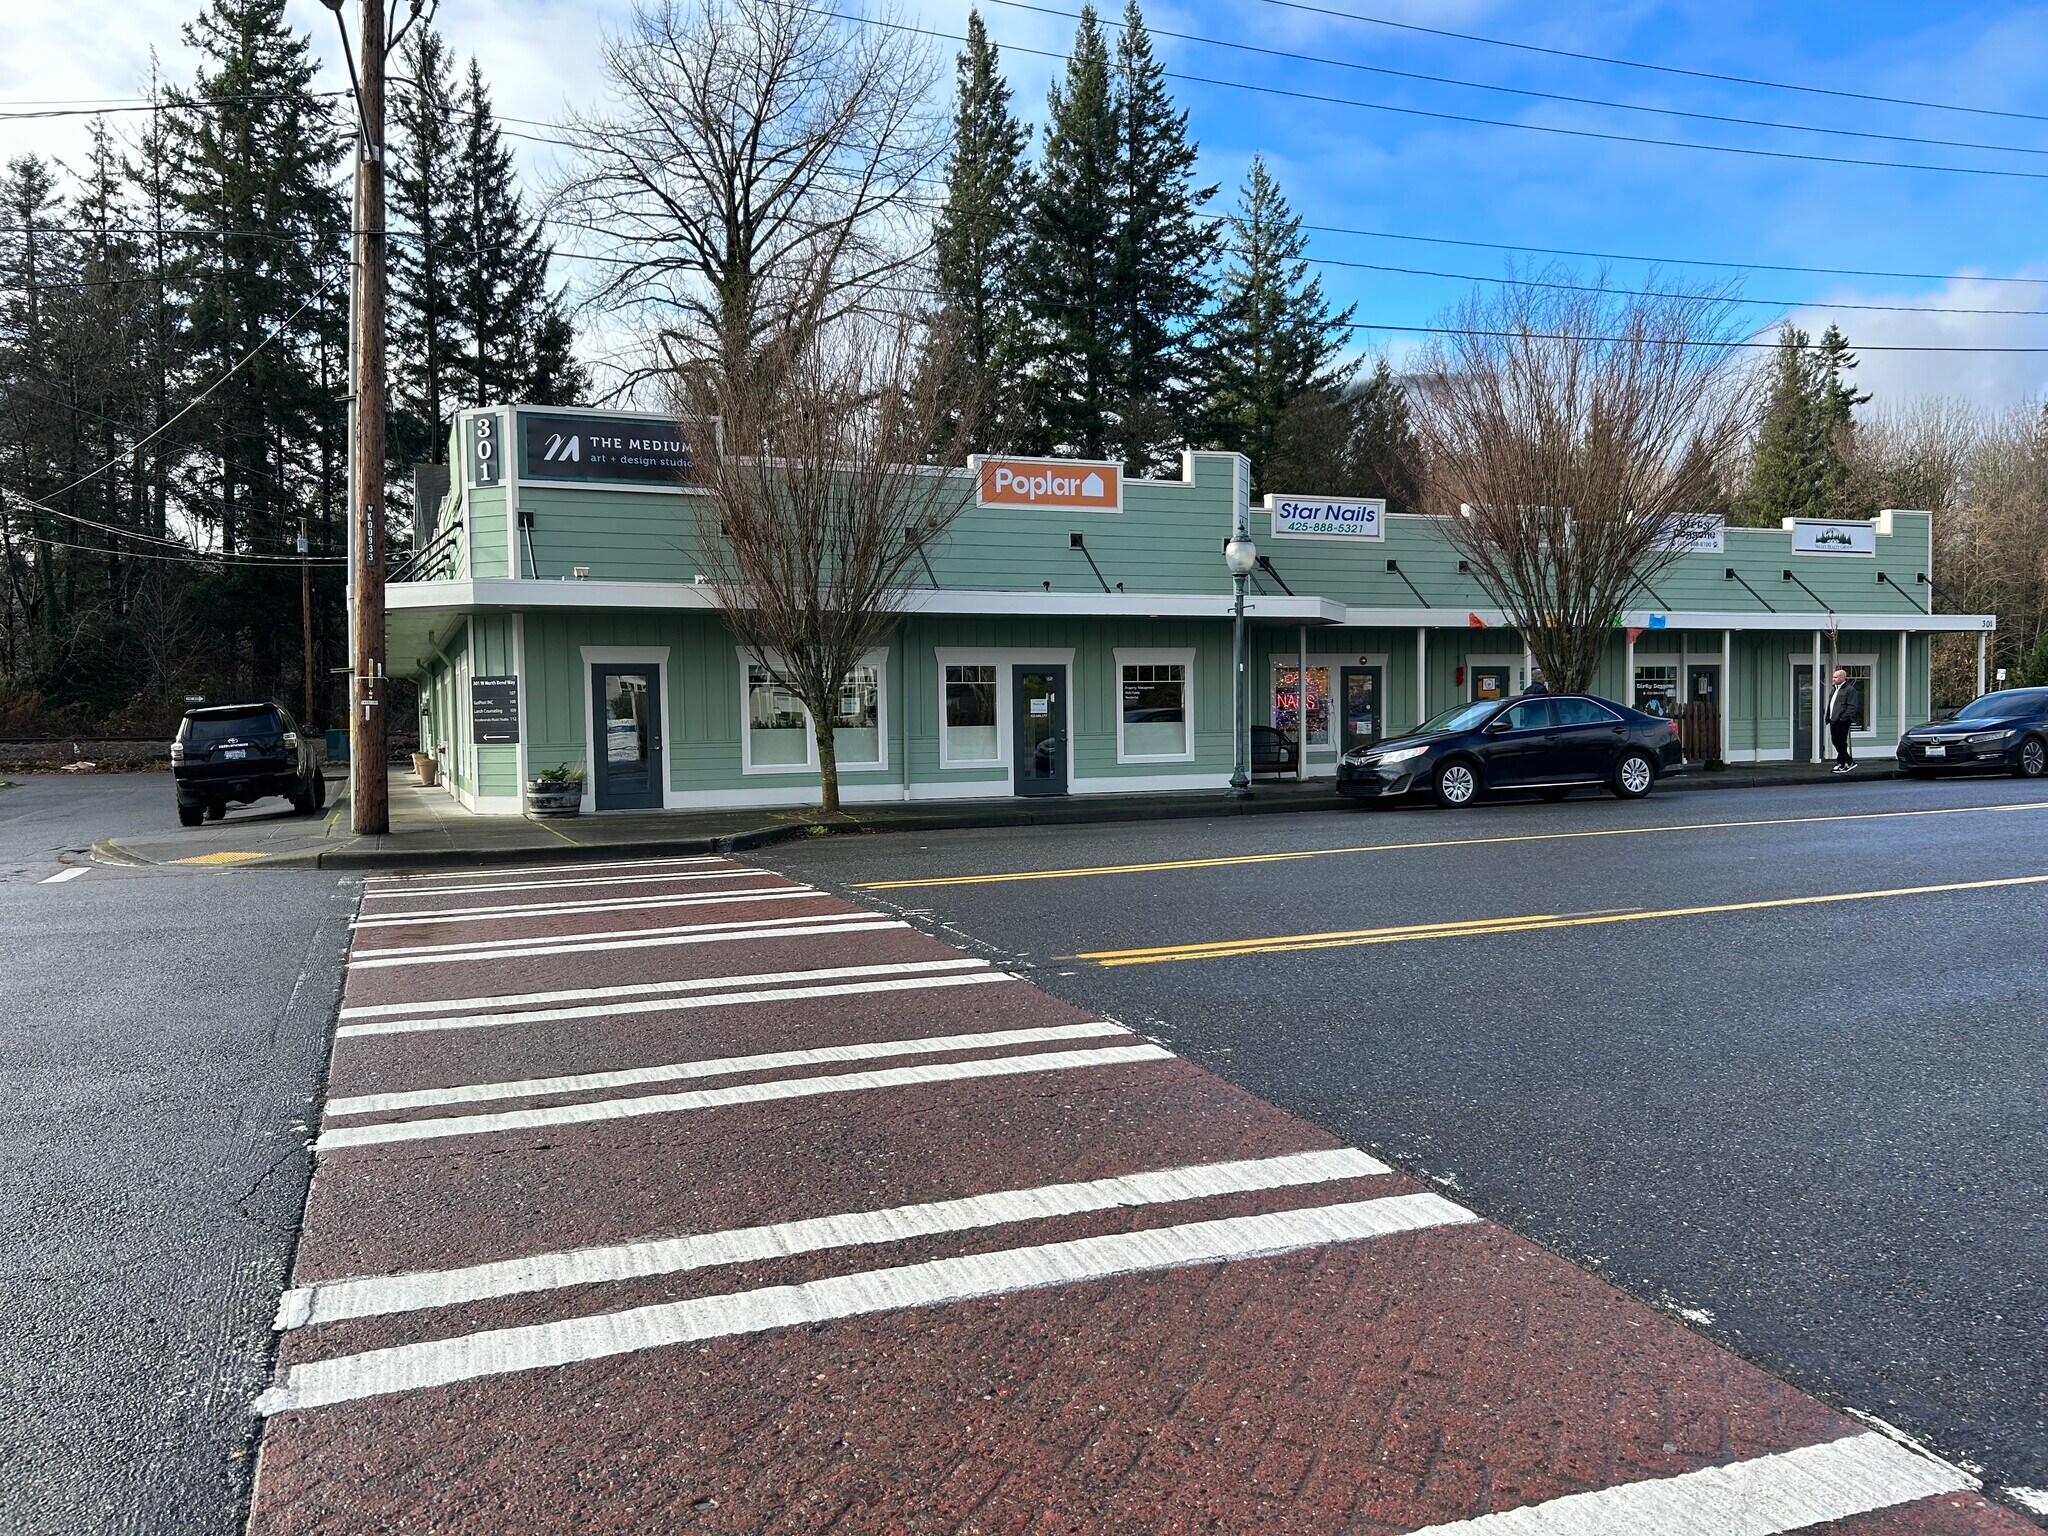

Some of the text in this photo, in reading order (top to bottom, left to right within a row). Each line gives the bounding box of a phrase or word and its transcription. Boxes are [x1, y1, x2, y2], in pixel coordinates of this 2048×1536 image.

[477, 418, 491, 481] 301
[590, 436, 693, 453] THE MEDIUM
[590, 454, 606, 463] art
[620, 455, 657, 467] design
[995, 468, 1080, 500] Poplar
[1280, 503, 1375, 522] Star Nails
[1288, 522, 1363, 533] 425-888-5321
[1982, 620, 1993, 628] 301
